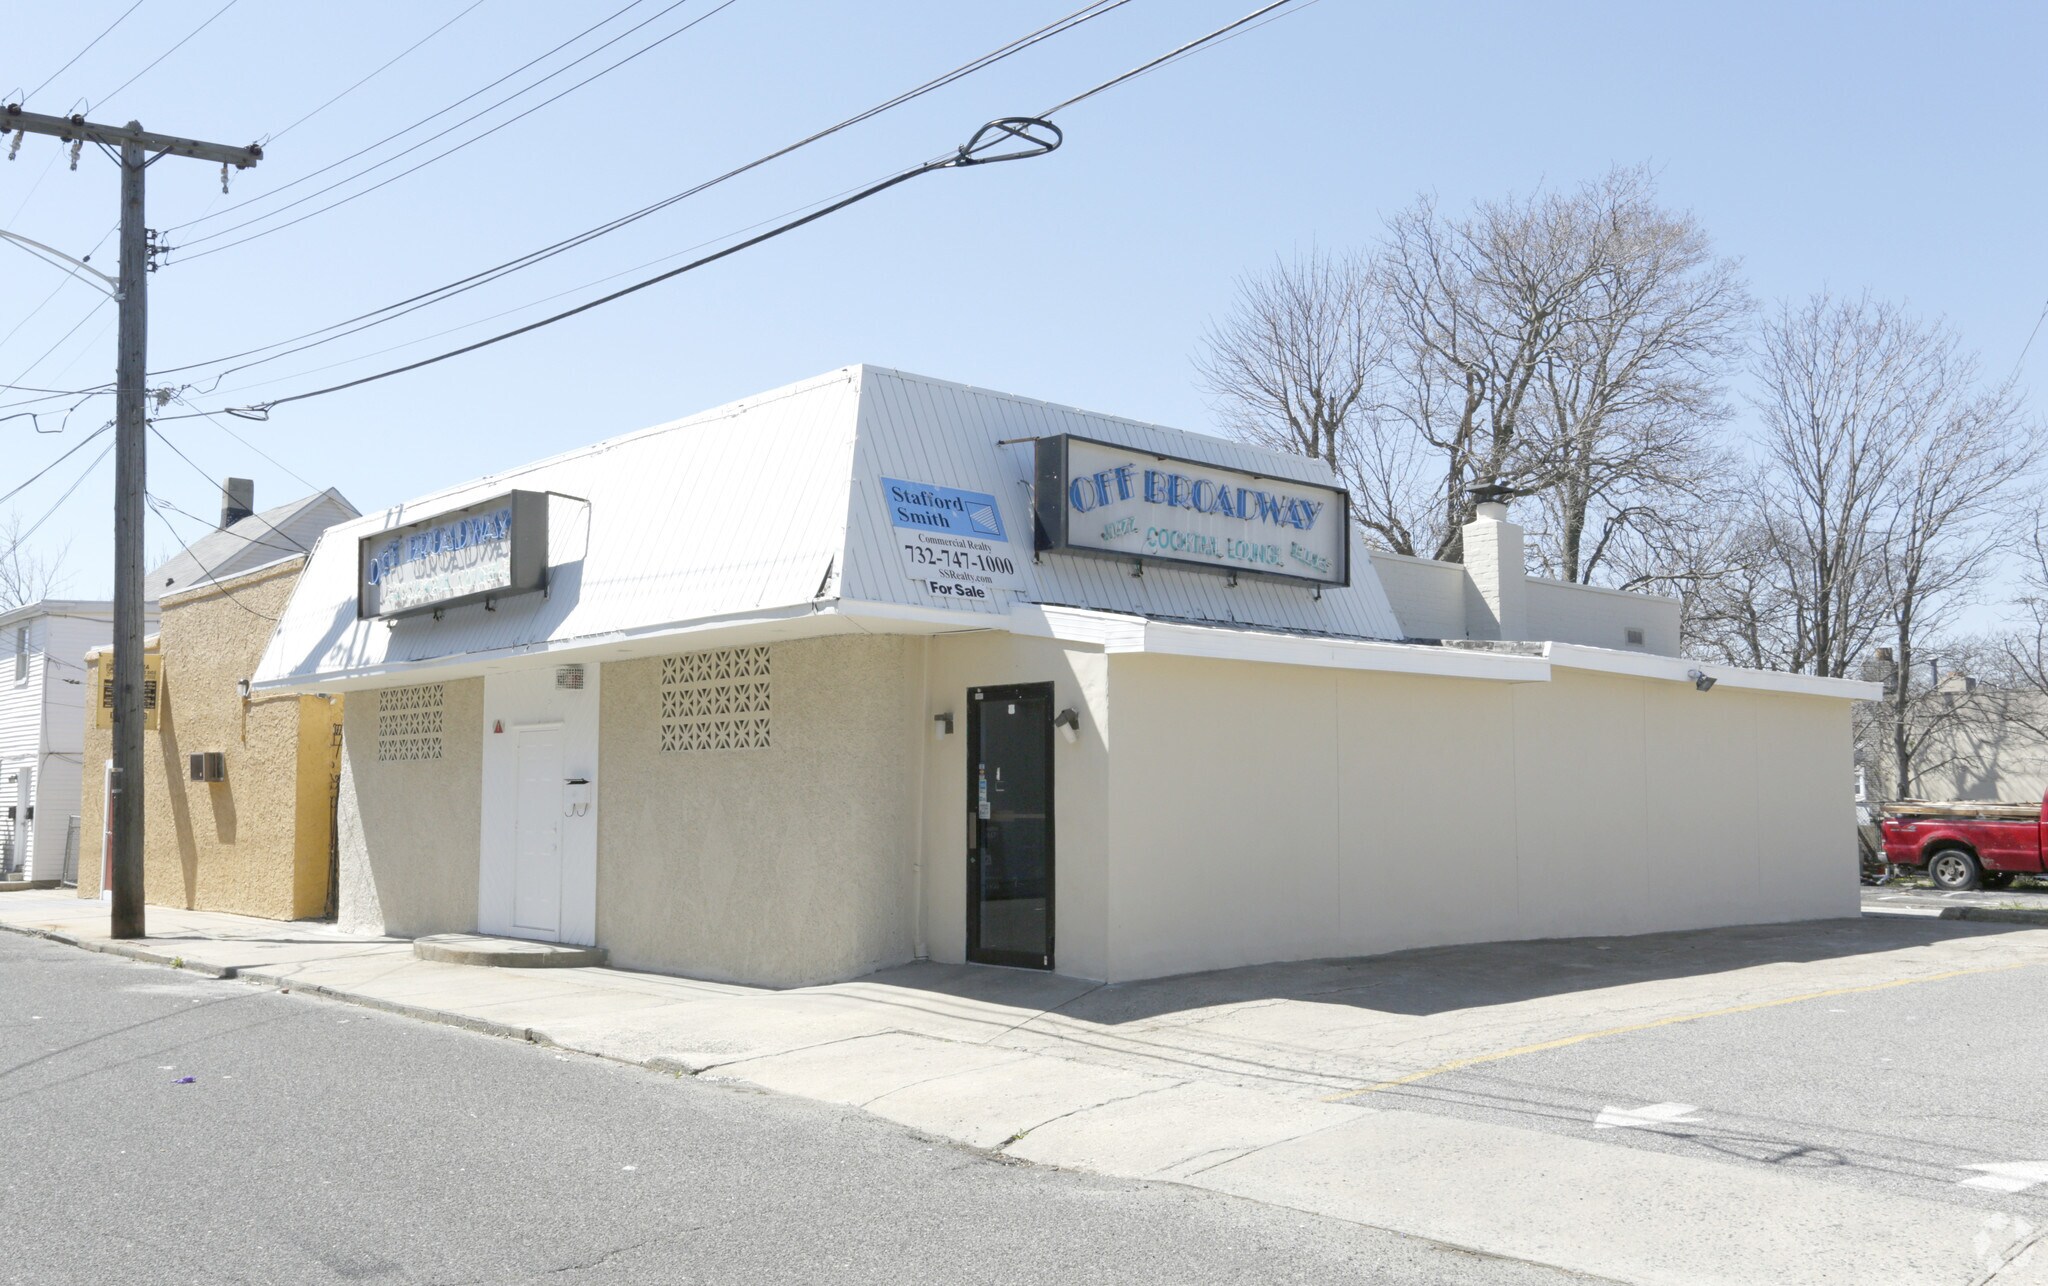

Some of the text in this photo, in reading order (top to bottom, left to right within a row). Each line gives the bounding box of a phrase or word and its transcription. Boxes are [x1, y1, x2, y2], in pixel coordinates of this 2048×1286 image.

[891, 486, 964, 512] Stafford
[1070, 463, 1324, 531] OFF BROADWAY
[897, 507, 950, 528] Smith
[918, 533, 992, 553] Commercial Realty
[1147, 527, 1281, 565] COCKTAIL LOUNGE
[905, 545, 1014, 575] 732-747-1000
[938, 568, 993, 584] SSRealty.com
[930, 581, 985, 598] For Sale
